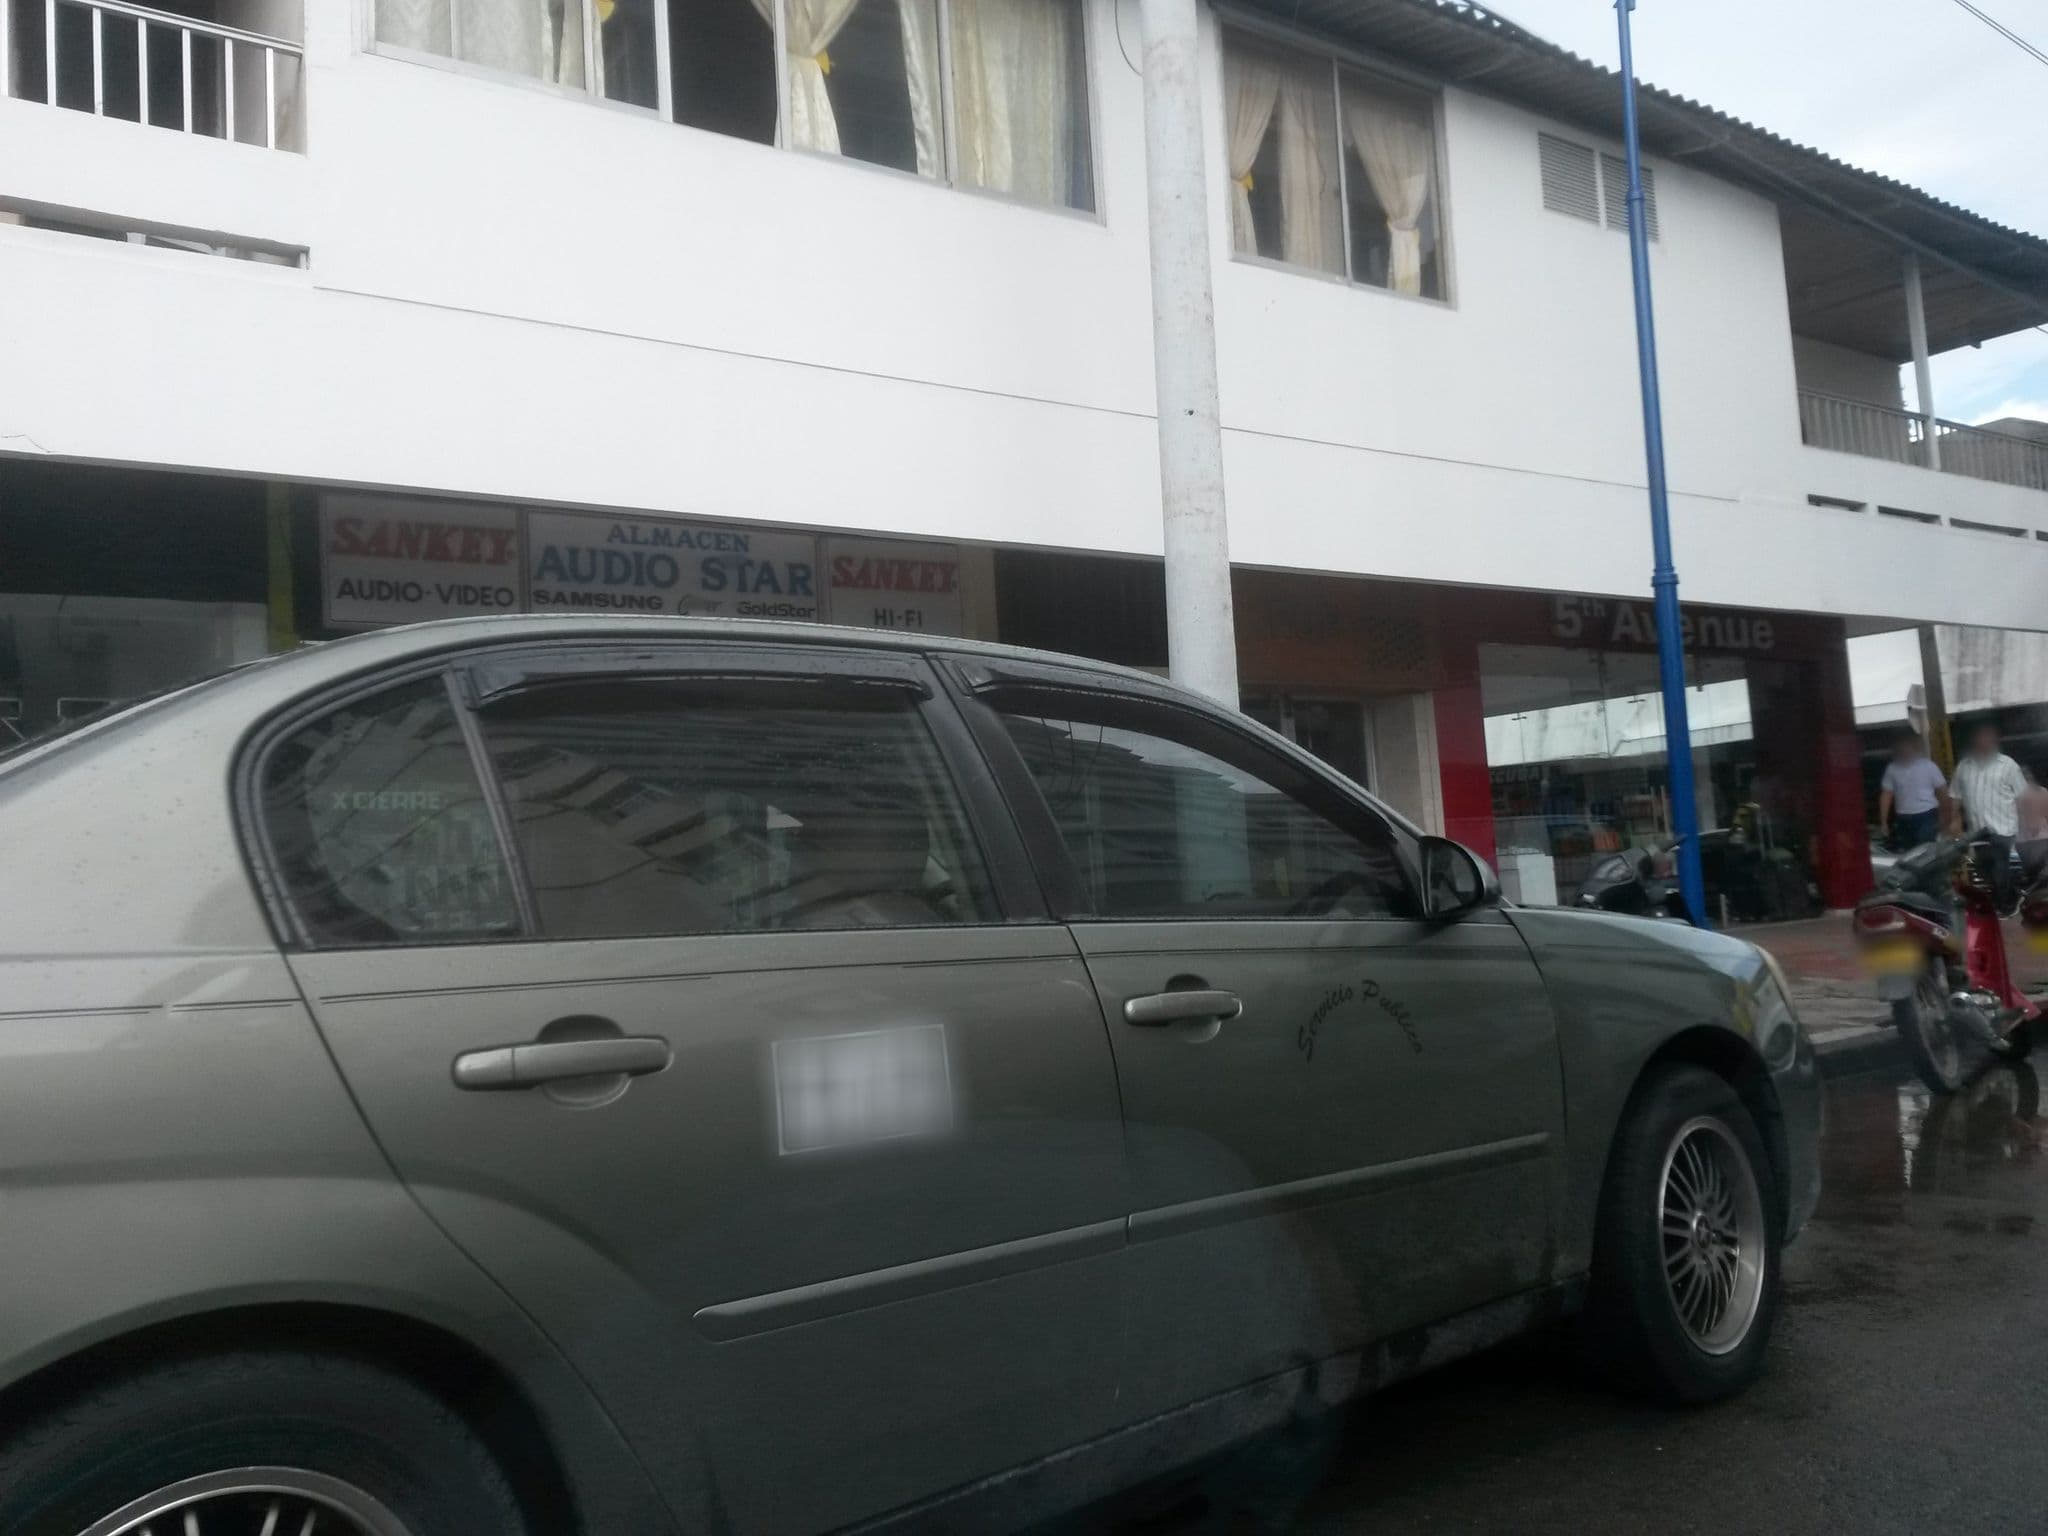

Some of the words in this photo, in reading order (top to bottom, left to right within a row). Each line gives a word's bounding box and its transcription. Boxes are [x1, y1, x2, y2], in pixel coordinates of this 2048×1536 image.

[334, 517, 516, 566] SANKEY
[607, 523, 749, 553] ALMACEN
[534, 546, 680, 589] AUDIO
[702, 556, 814, 597] STAR
[832, 556, 958, 594] SANKEY
[532, 589, 663, 611] SAMSUNG
[873, 607, 923, 628] HI-FI
